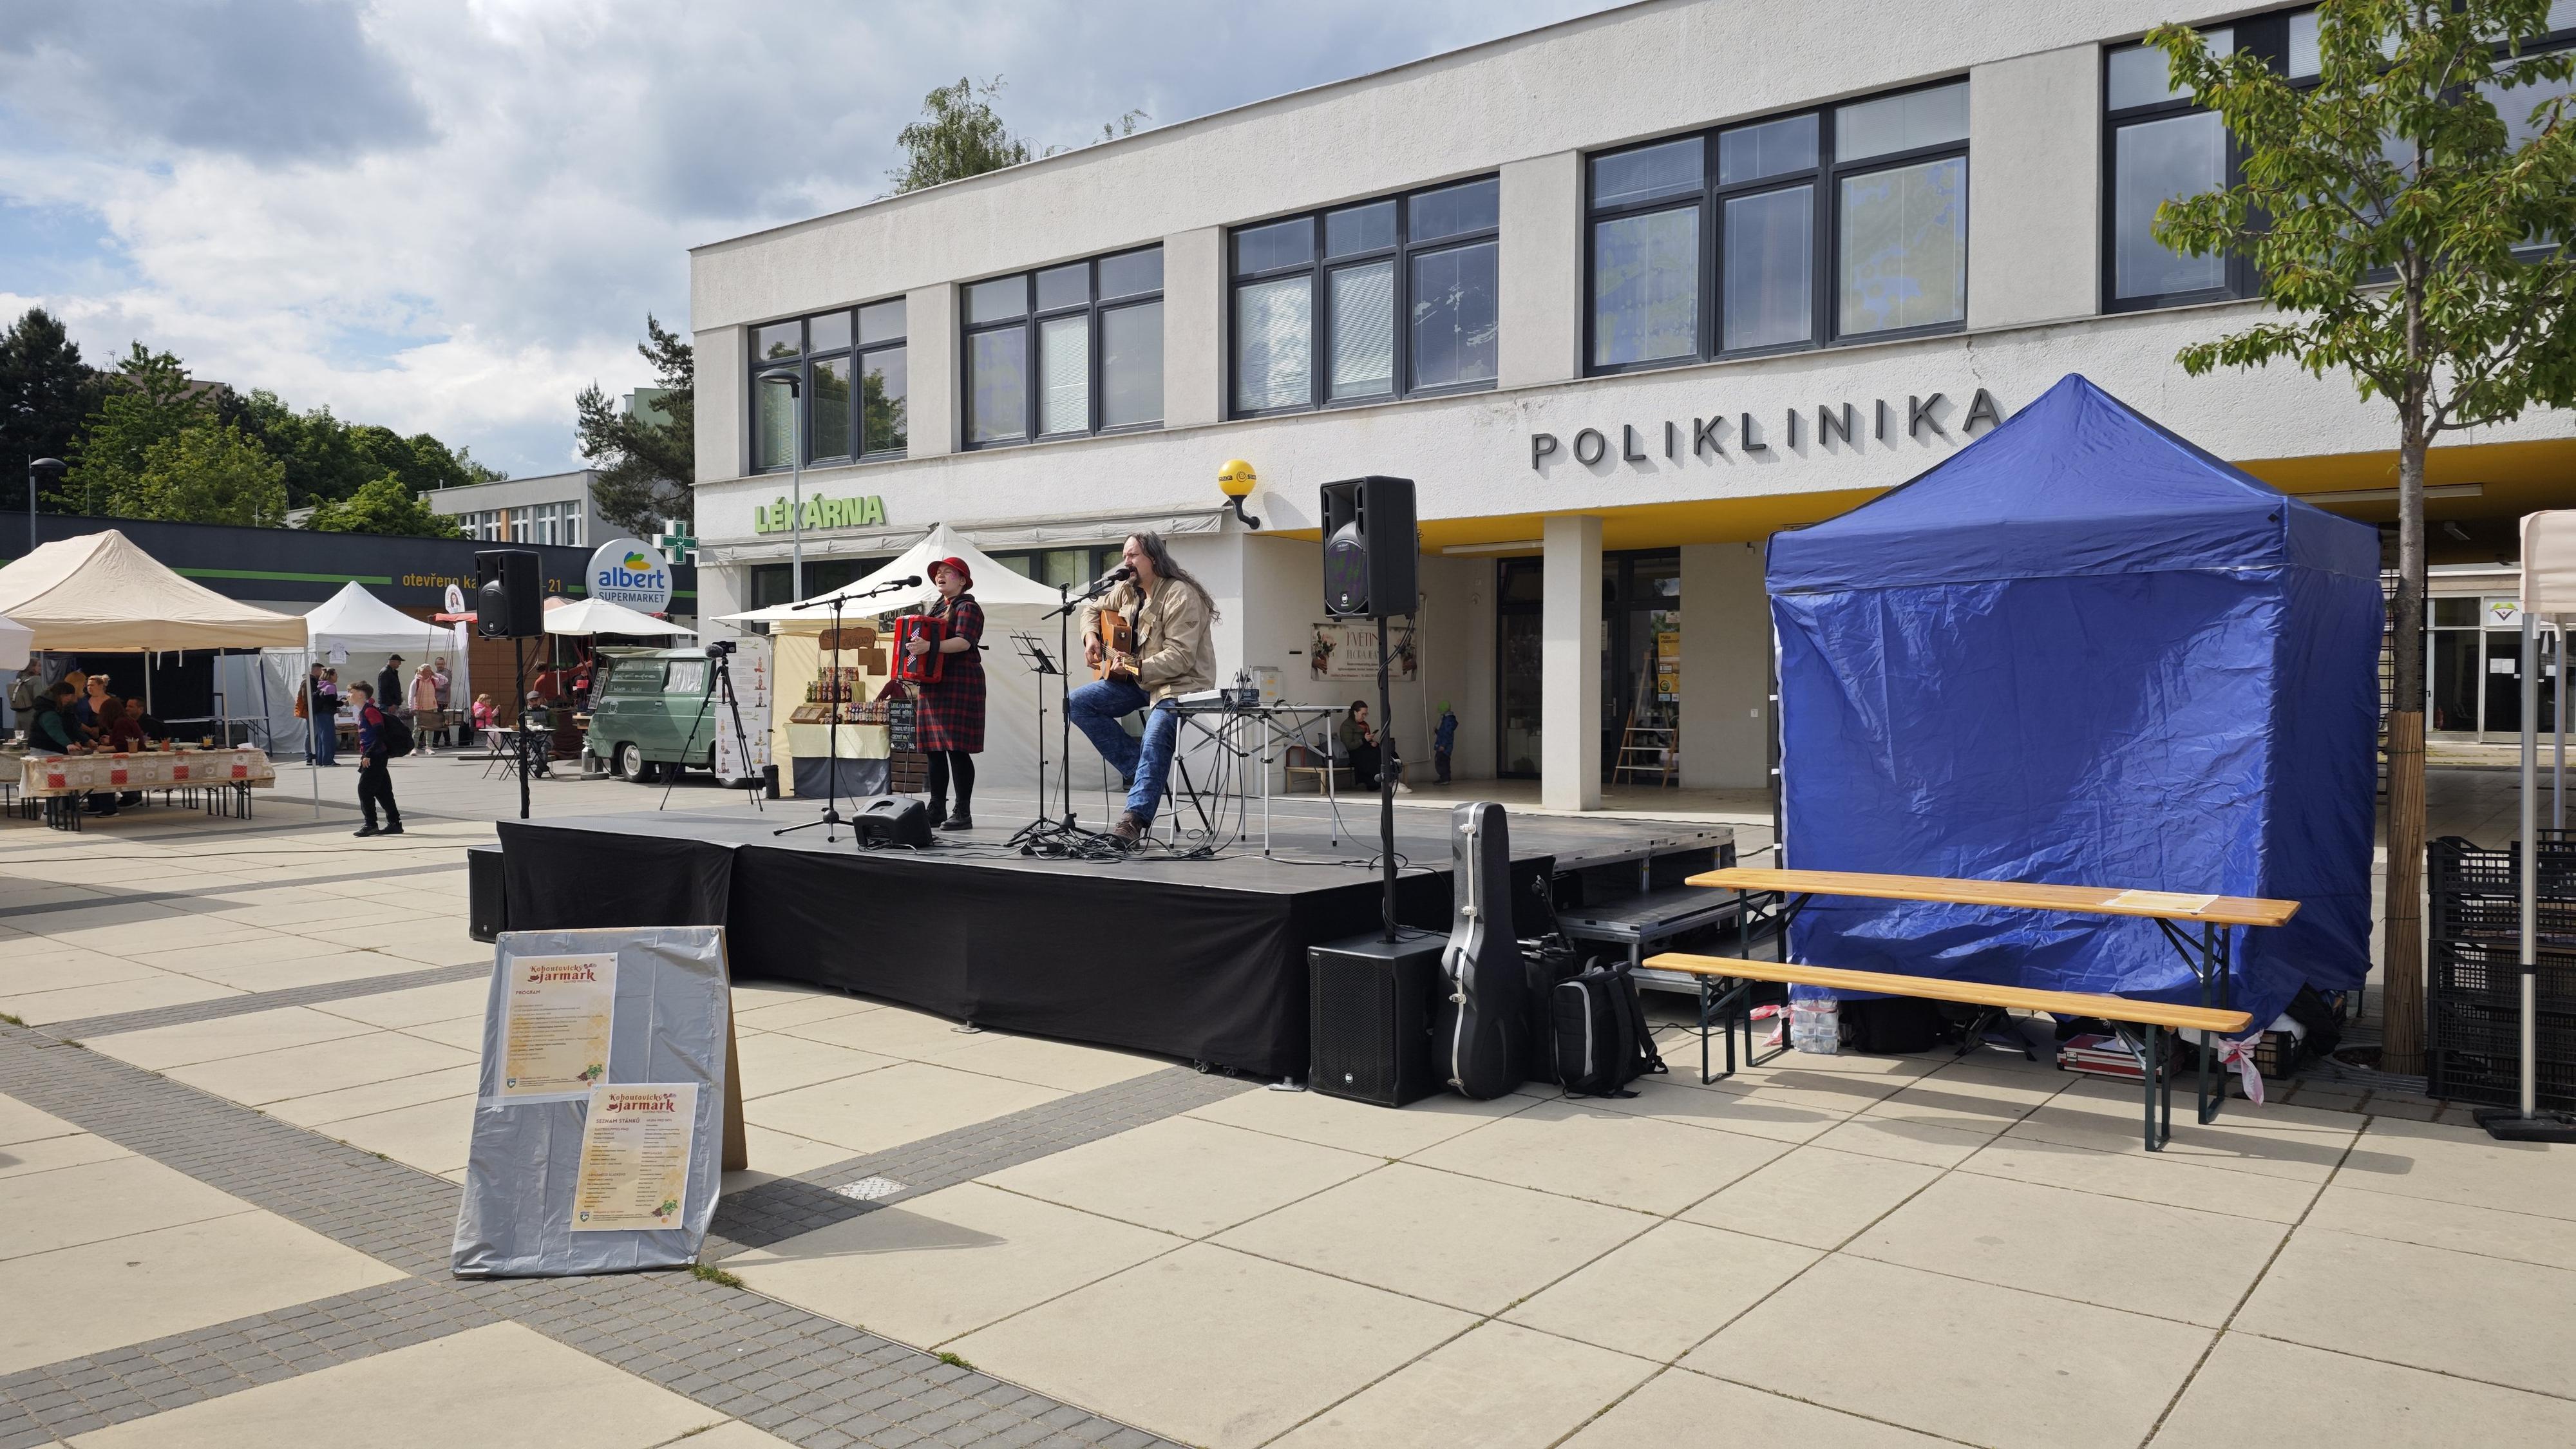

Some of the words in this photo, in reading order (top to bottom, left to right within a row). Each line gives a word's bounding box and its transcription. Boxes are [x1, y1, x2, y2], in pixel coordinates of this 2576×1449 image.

[1531, 388, 2002, 469] POLIKLINIKA
[754, 493, 887, 533] LÉKÁRNA
[402, 573, 459, 587] otevřeno
[598, 567, 665, 589] albert
[599, 592, 665, 603] SUPERMARKET
[1347, 629, 1378, 647] KVĚTIN
[529, 964, 583, 973] Kohoutovický
[536, 969, 597, 984] jarmark
[609, 1093, 662, 1102] Kohoutovický
[614, 1099, 676, 1113] jarmark
